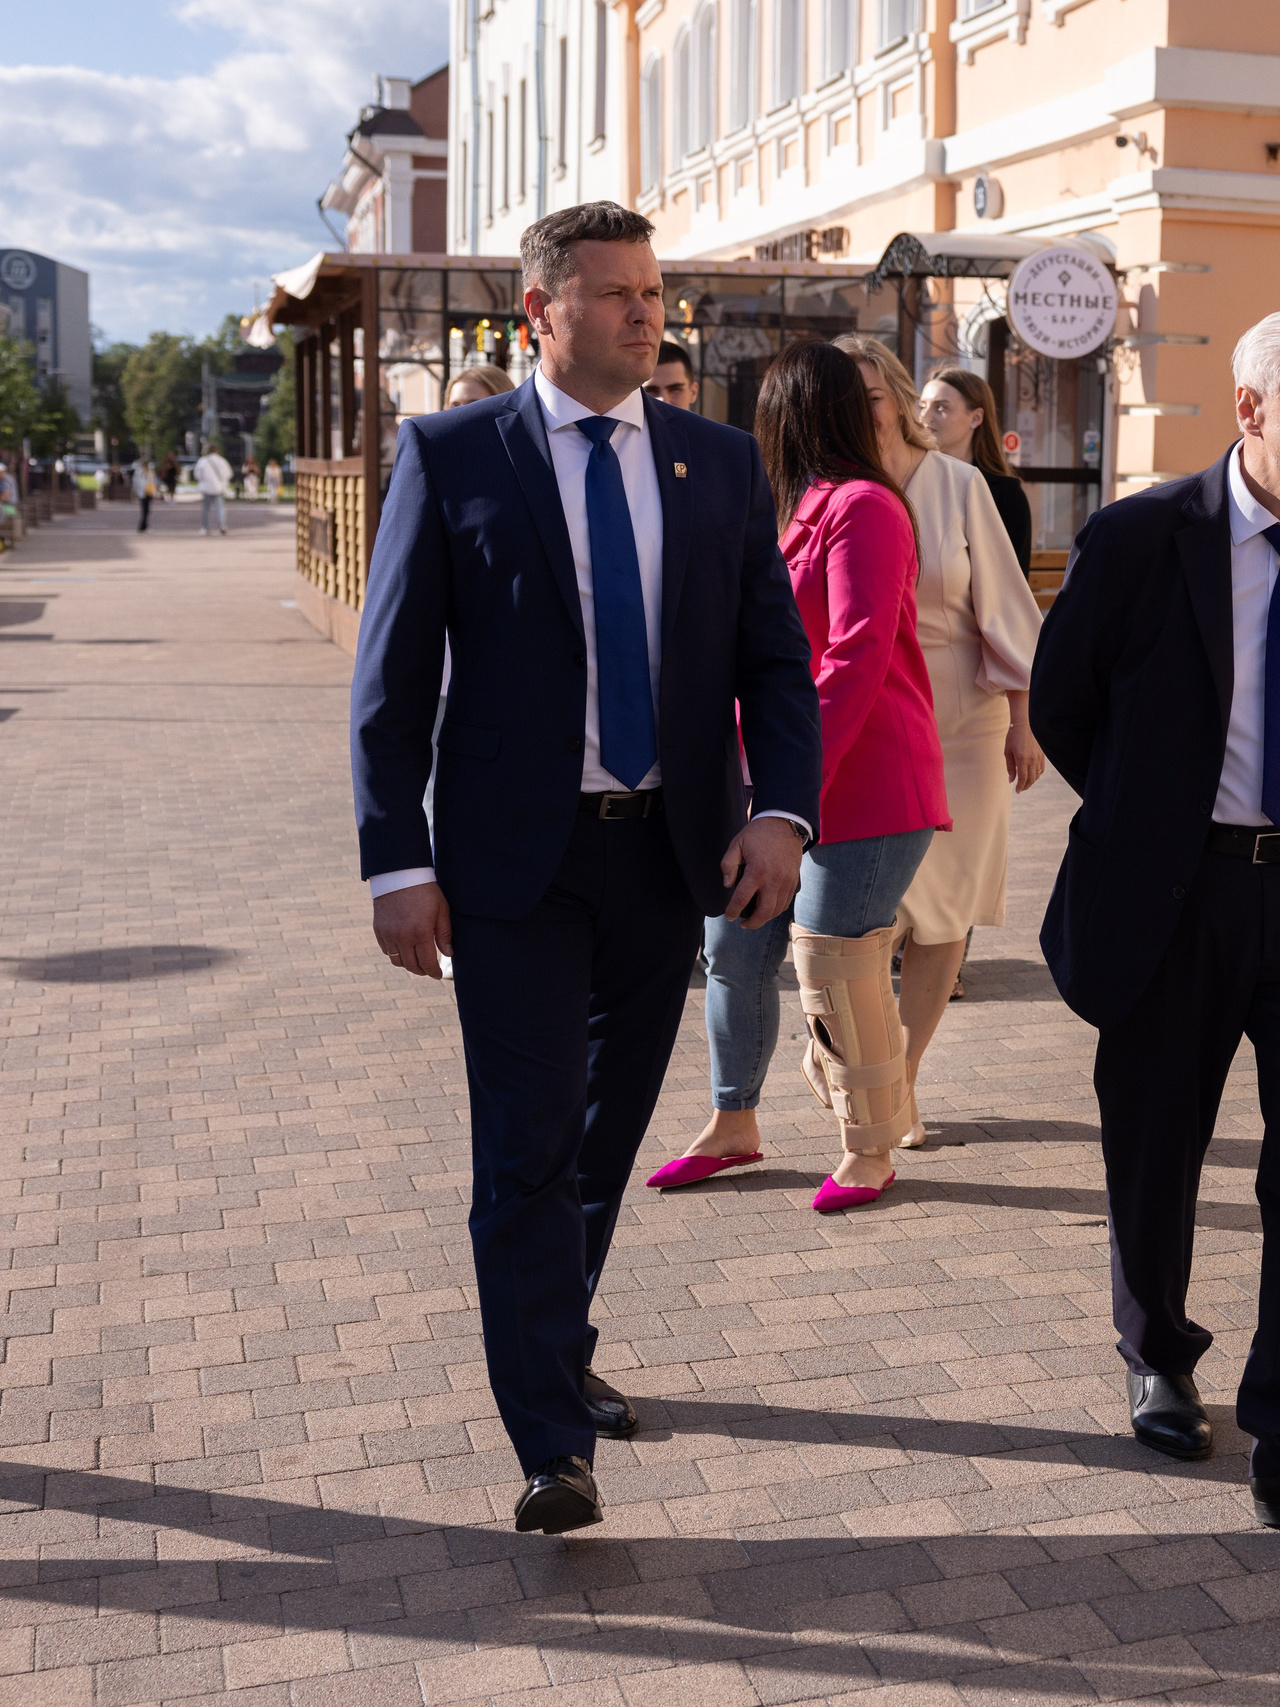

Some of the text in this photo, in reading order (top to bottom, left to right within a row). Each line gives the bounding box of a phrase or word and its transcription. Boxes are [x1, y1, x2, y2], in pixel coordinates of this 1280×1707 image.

[1029, 254, 1100, 280] ДЕГУСТАЦИИ
[1014, 292, 1113, 310] МЕСТНЫЕ
[1051, 315, 1077, 325] БАР
